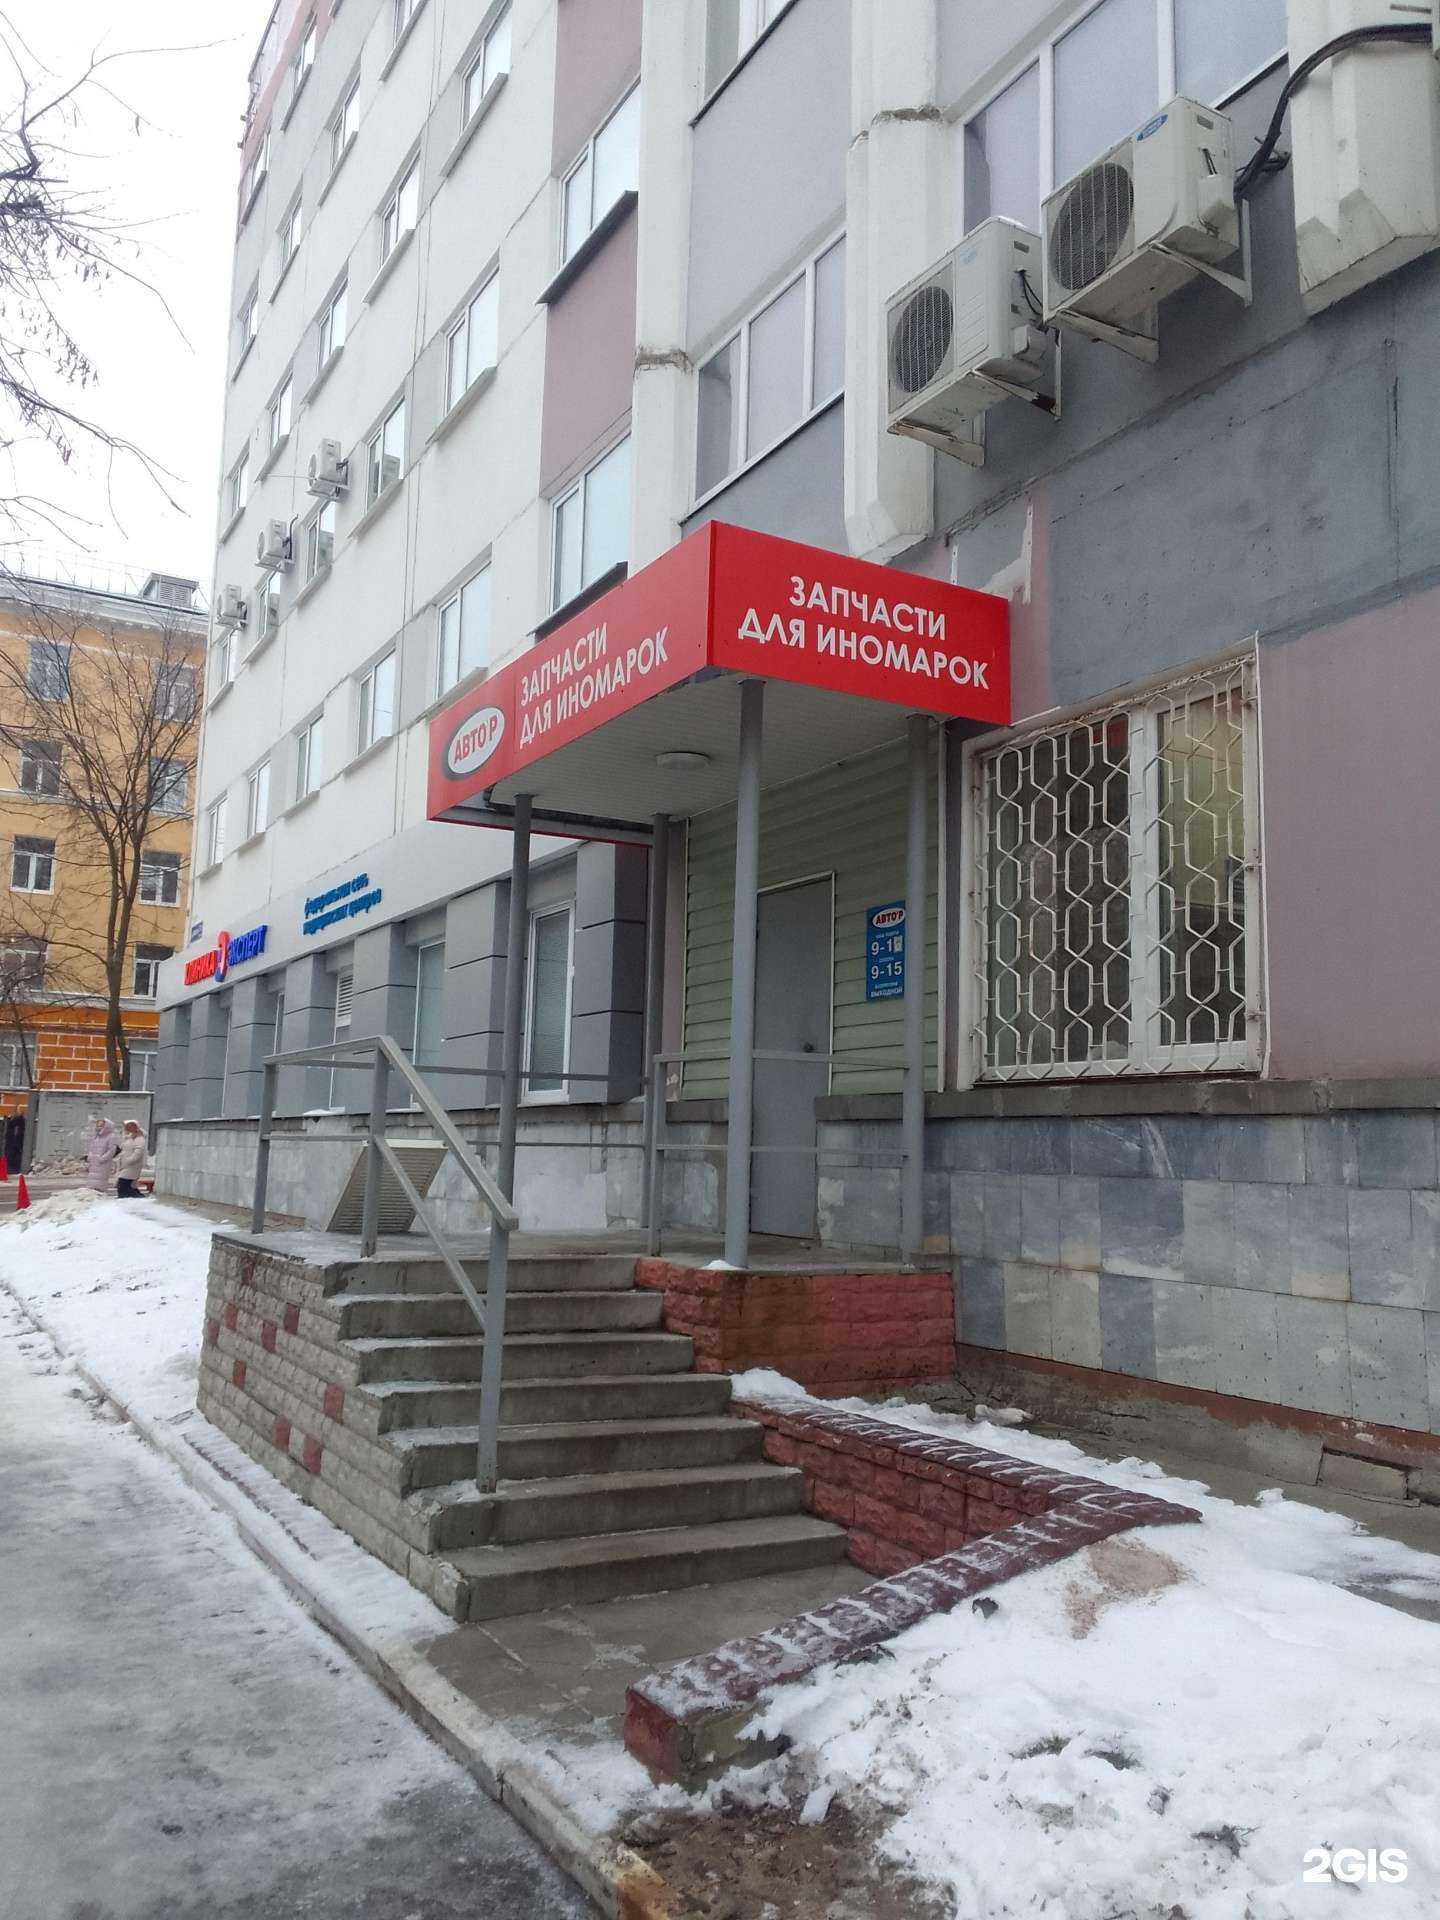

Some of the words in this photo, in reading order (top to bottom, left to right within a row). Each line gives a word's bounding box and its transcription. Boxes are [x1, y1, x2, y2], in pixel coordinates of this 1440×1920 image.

[737, 607, 806, 649] ДЛЯ
[816, 623, 990, 690] ИНОМАРОК
[788, 575, 946, 641] ЗАПЧАСТИ
[519, 699, 552, 750] ДЛЯ
[556, 627, 669, 724] ИНОМАРОК
[520, 622, 608, 706] ЗАПЧАСТИ
[871, 961, 903, 980] 9-15
